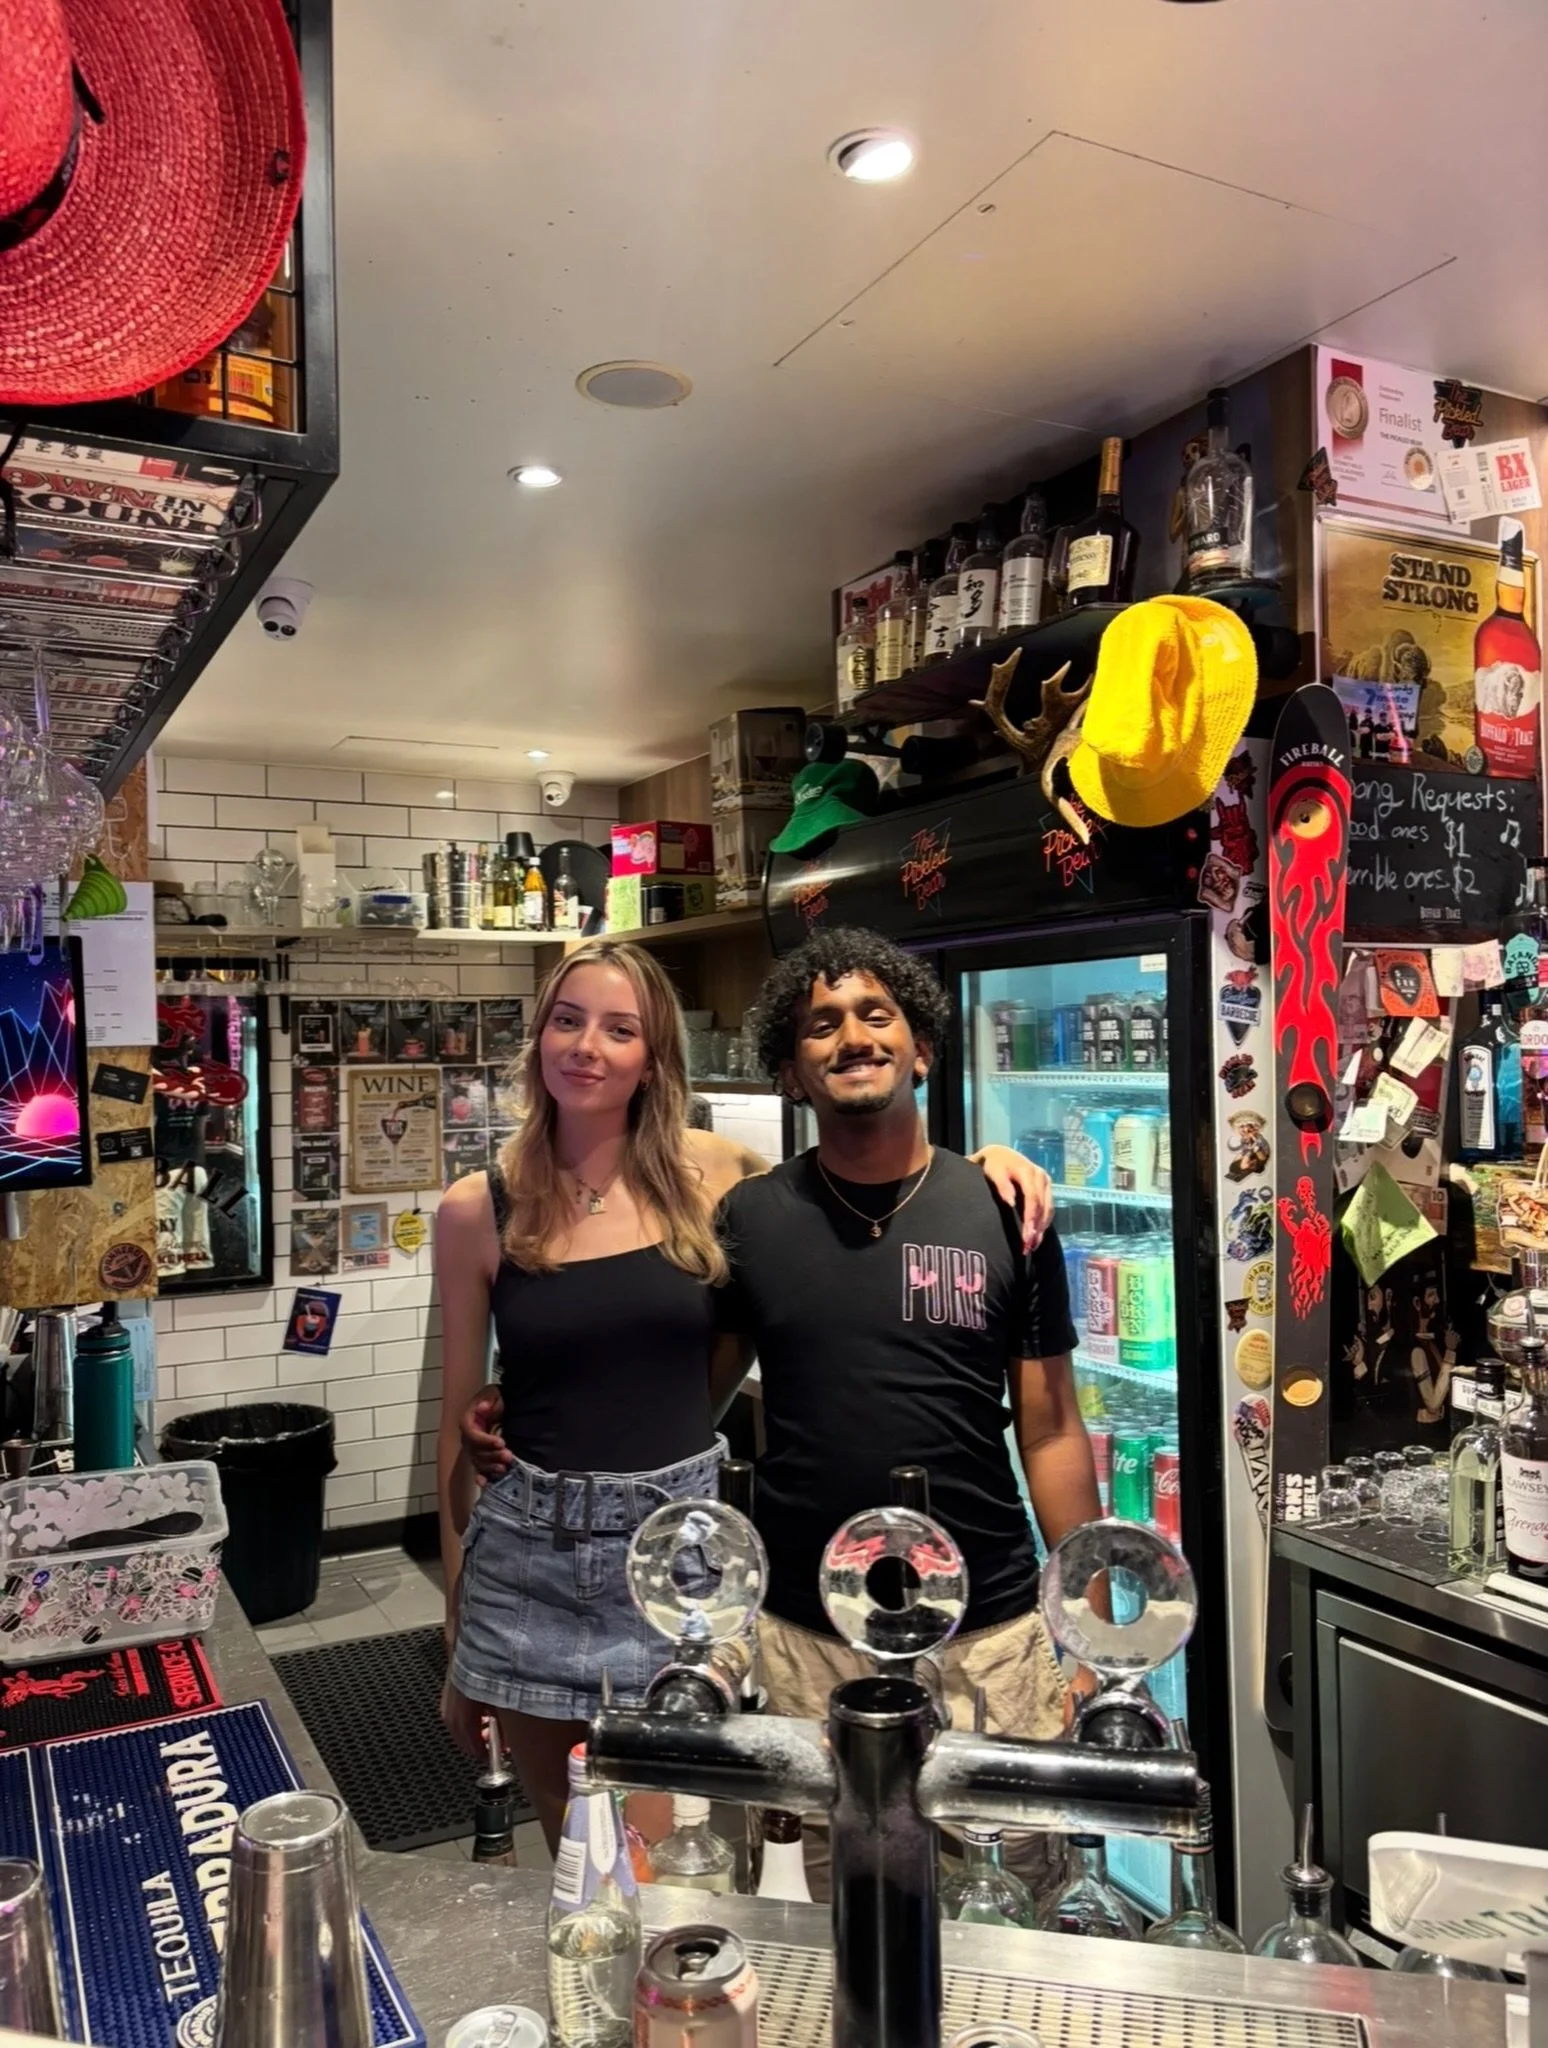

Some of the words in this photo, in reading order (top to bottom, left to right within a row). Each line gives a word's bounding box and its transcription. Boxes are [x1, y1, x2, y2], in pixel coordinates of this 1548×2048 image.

[1379, 407, 1423, 433] Finalist
[1496, 452, 1529, 480] BX
[1501, 478, 1532, 493] LAGER
[164, 496, 205, 512] IN
[1390, 554, 1472, 588] STAND
[1382, 577, 1479, 614] STRONG
[1280, 742, 1345, 768] FIREBALL
[1411, 772, 1515, 823] Requests:
[1349, 807, 1380, 840] ood
[1391, 824, 1430, 842] ones
[1444, 820, 1471, 859] $1
[1404, 867, 1450, 889] ones
[1452, 860, 1481, 903] $2
[1220, 1003, 1259, 1023] BARBECUE
[362, 1075, 430, 1094] WINE
[1430, 1190, 1446, 1203] 10
[902, 1243, 988, 1331] PURR
[1303, 1475, 1317, 1518] HELL
[161, 1650, 203, 1707] SERVICE
[161, 1731, 239, 1954] RADURA
[142, 1870, 200, 2002] TEQUILA
